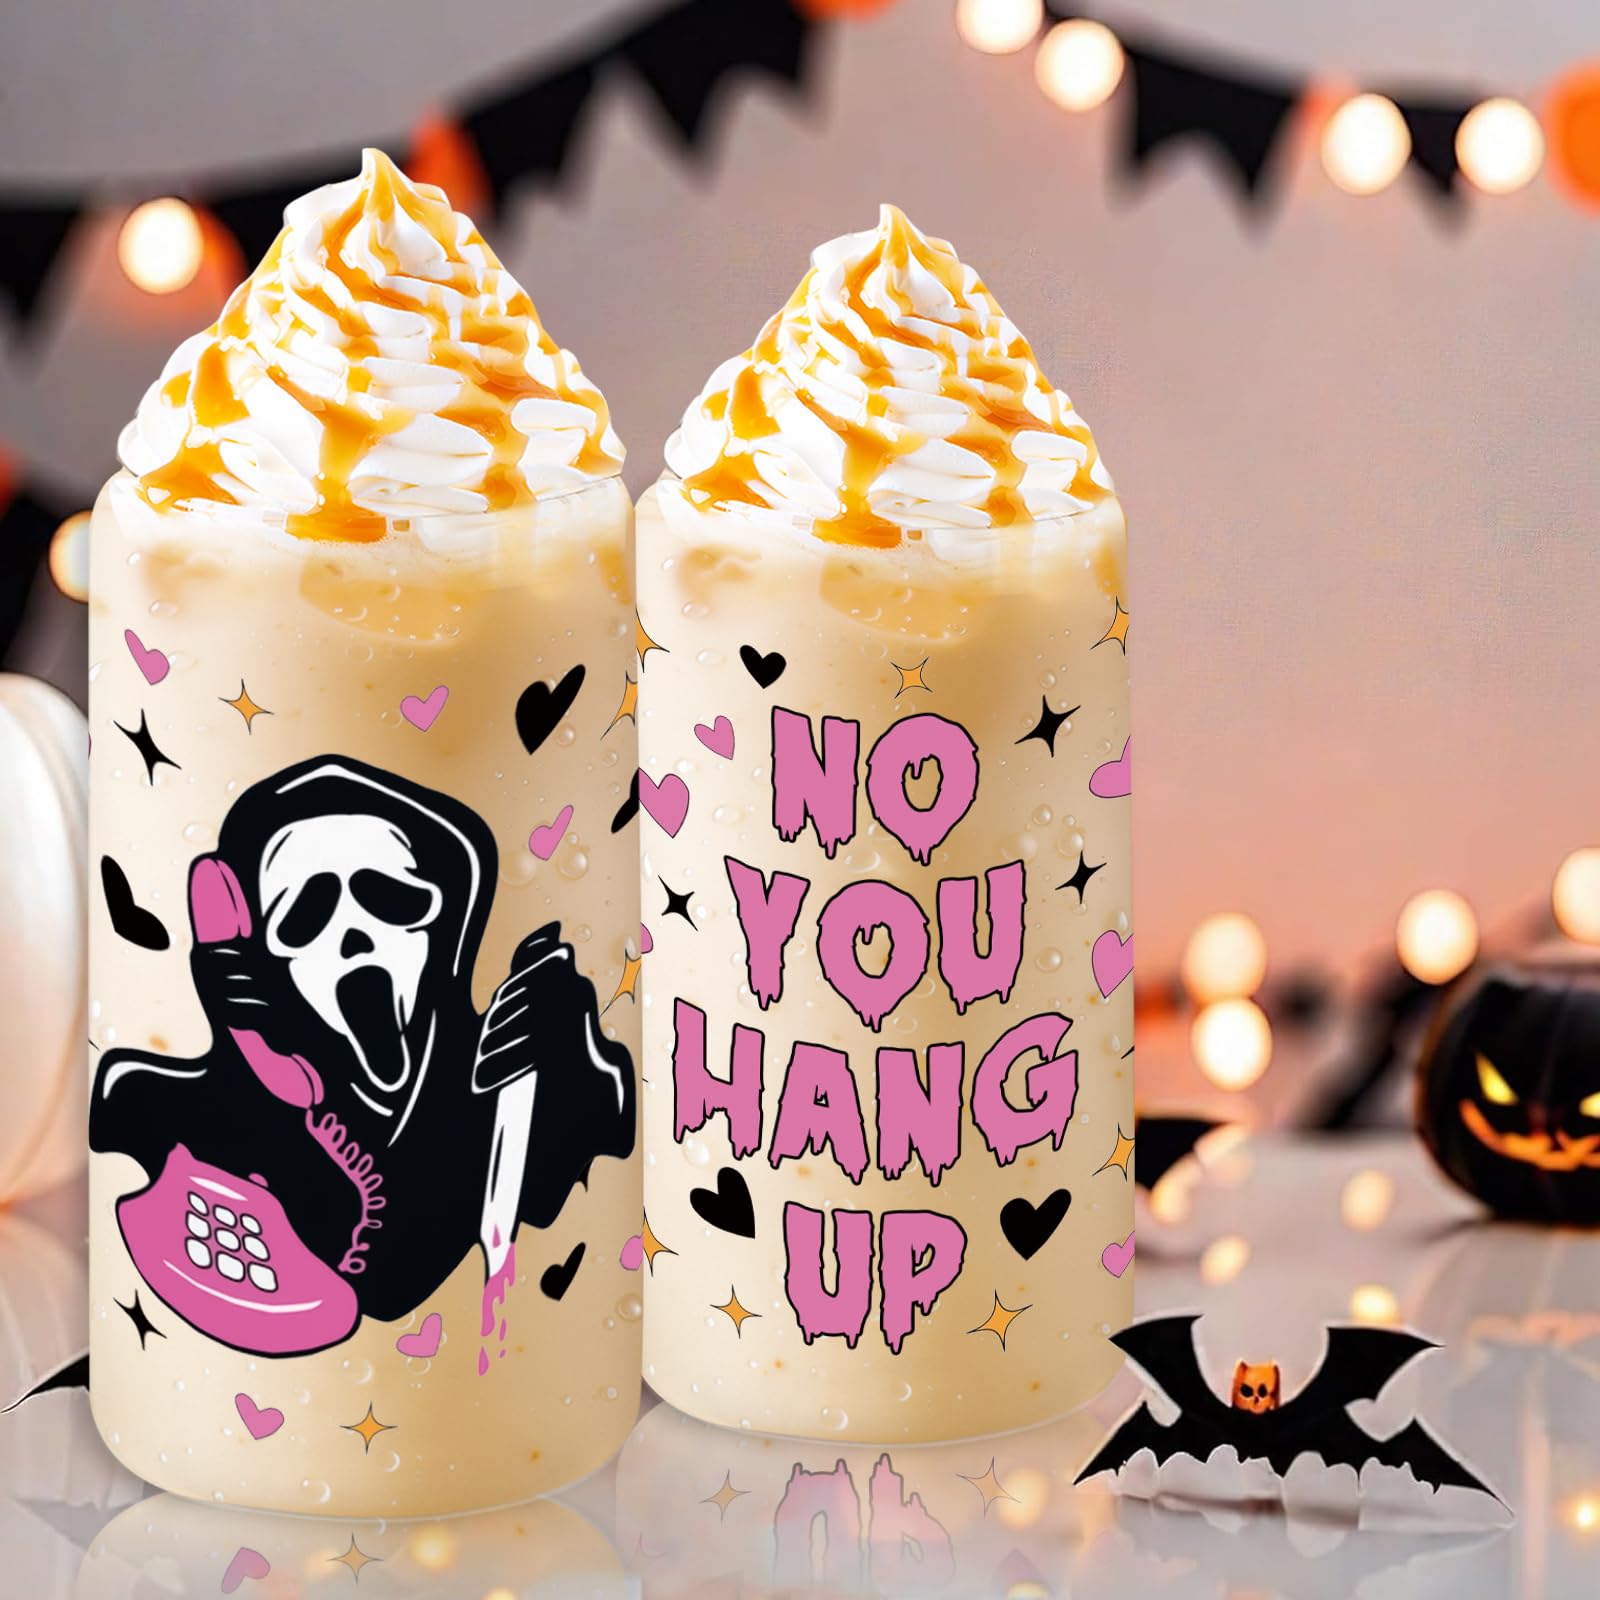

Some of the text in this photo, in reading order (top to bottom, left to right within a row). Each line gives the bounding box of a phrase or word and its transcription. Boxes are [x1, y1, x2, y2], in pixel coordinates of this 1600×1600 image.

[771, 705, 980, 866] NO
[724, 855, 1028, 1034] YOU
[672, 997, 1079, 1188] HANG
[782, 1201, 968, 1356] UP
